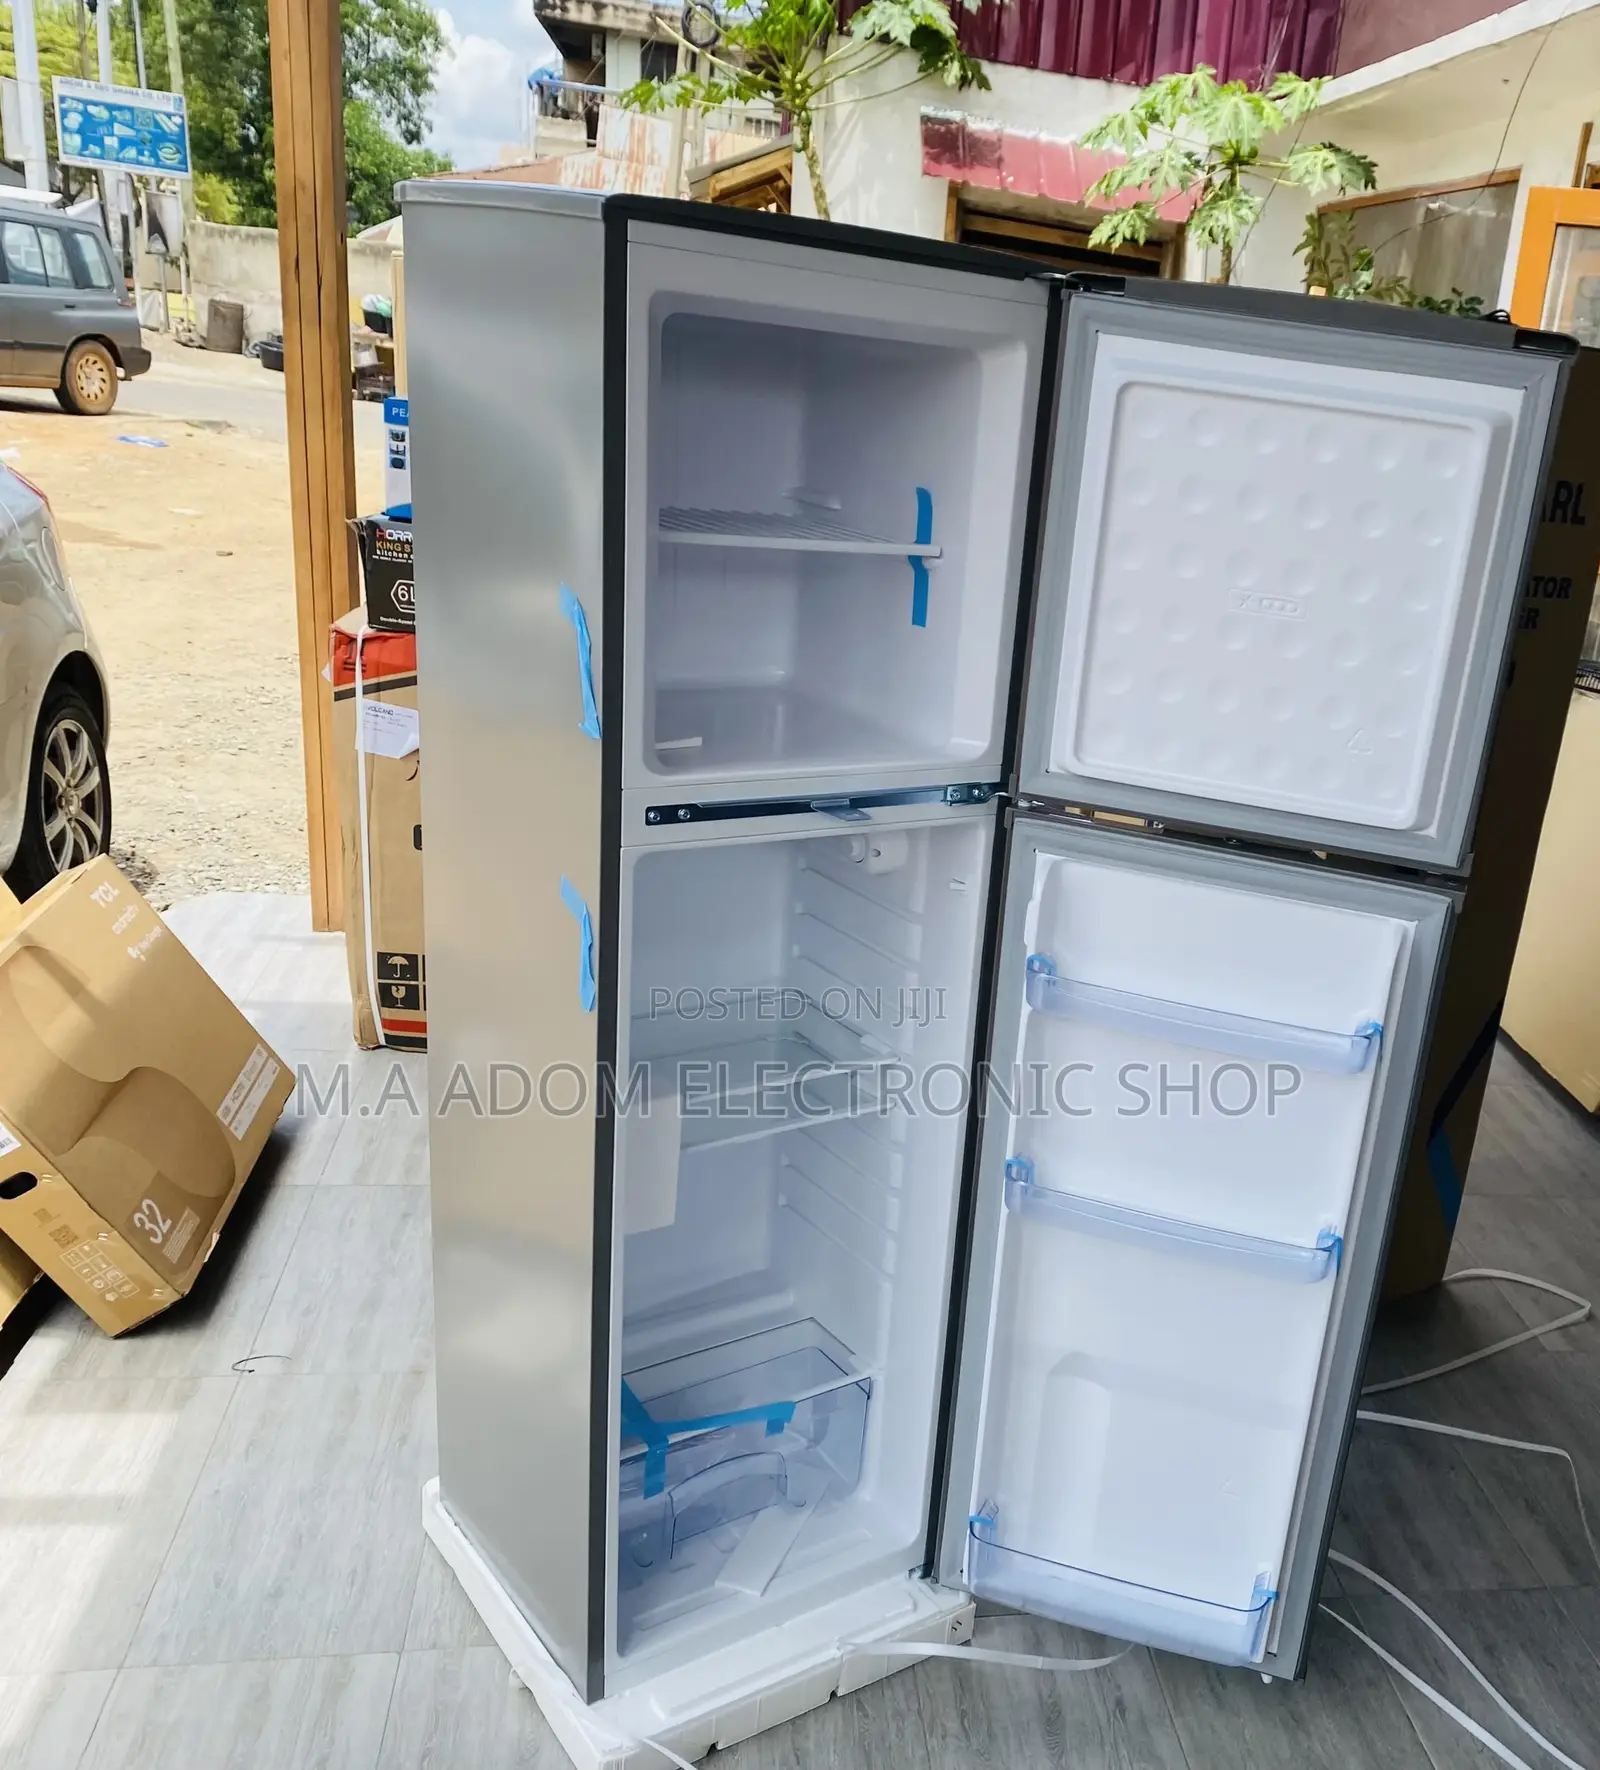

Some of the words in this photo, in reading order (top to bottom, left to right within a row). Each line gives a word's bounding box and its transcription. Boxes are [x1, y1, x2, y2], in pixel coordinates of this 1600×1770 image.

[376, 540, 402, 552] KING
[404, 544, 413, 553] S
[89, 880, 120, 908] TCL
[133, 1198, 173, 1244] 32
